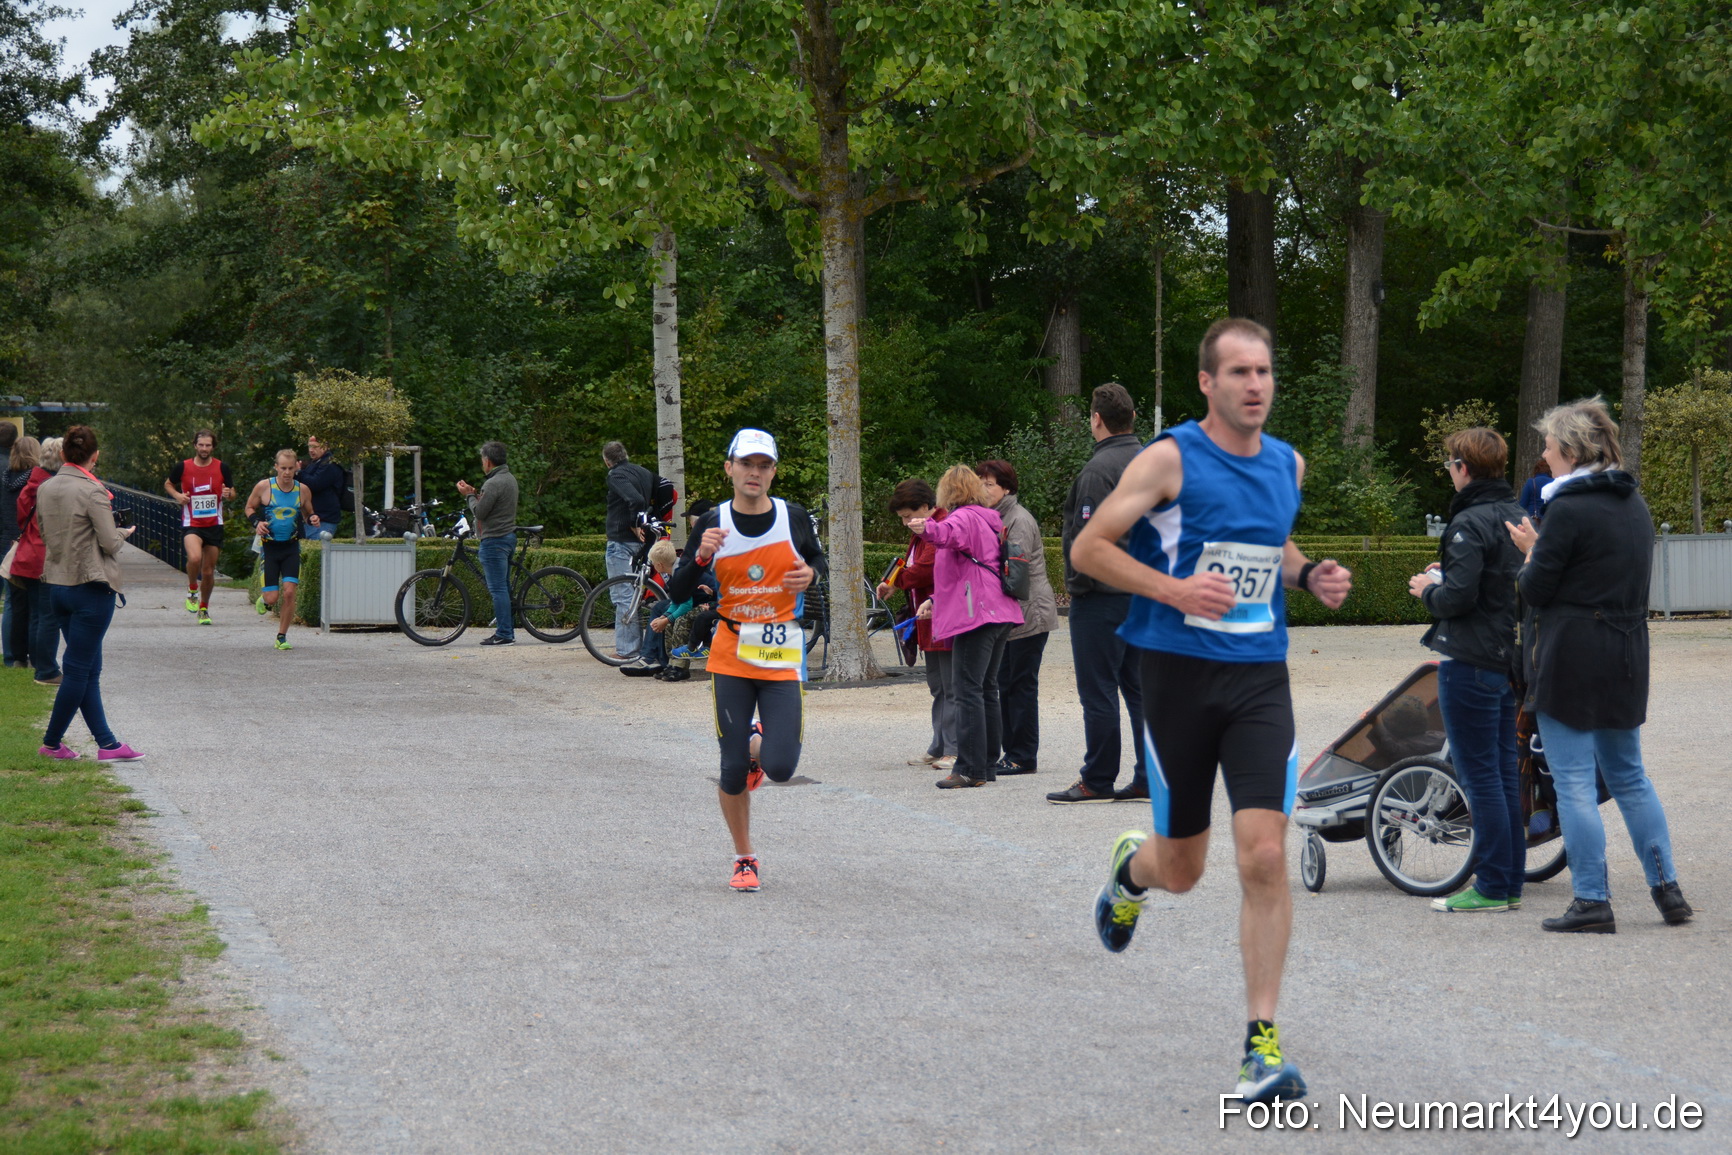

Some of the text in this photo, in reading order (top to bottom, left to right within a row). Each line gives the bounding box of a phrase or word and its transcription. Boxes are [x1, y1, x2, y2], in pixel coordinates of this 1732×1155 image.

[194, 500, 216, 510] 2186
[729, 585, 783, 595] SportScheck
[762, 623, 787, 645] 83
[759, 650, 783, 660] Hynek
[1309, 784, 1349, 797] chariot
